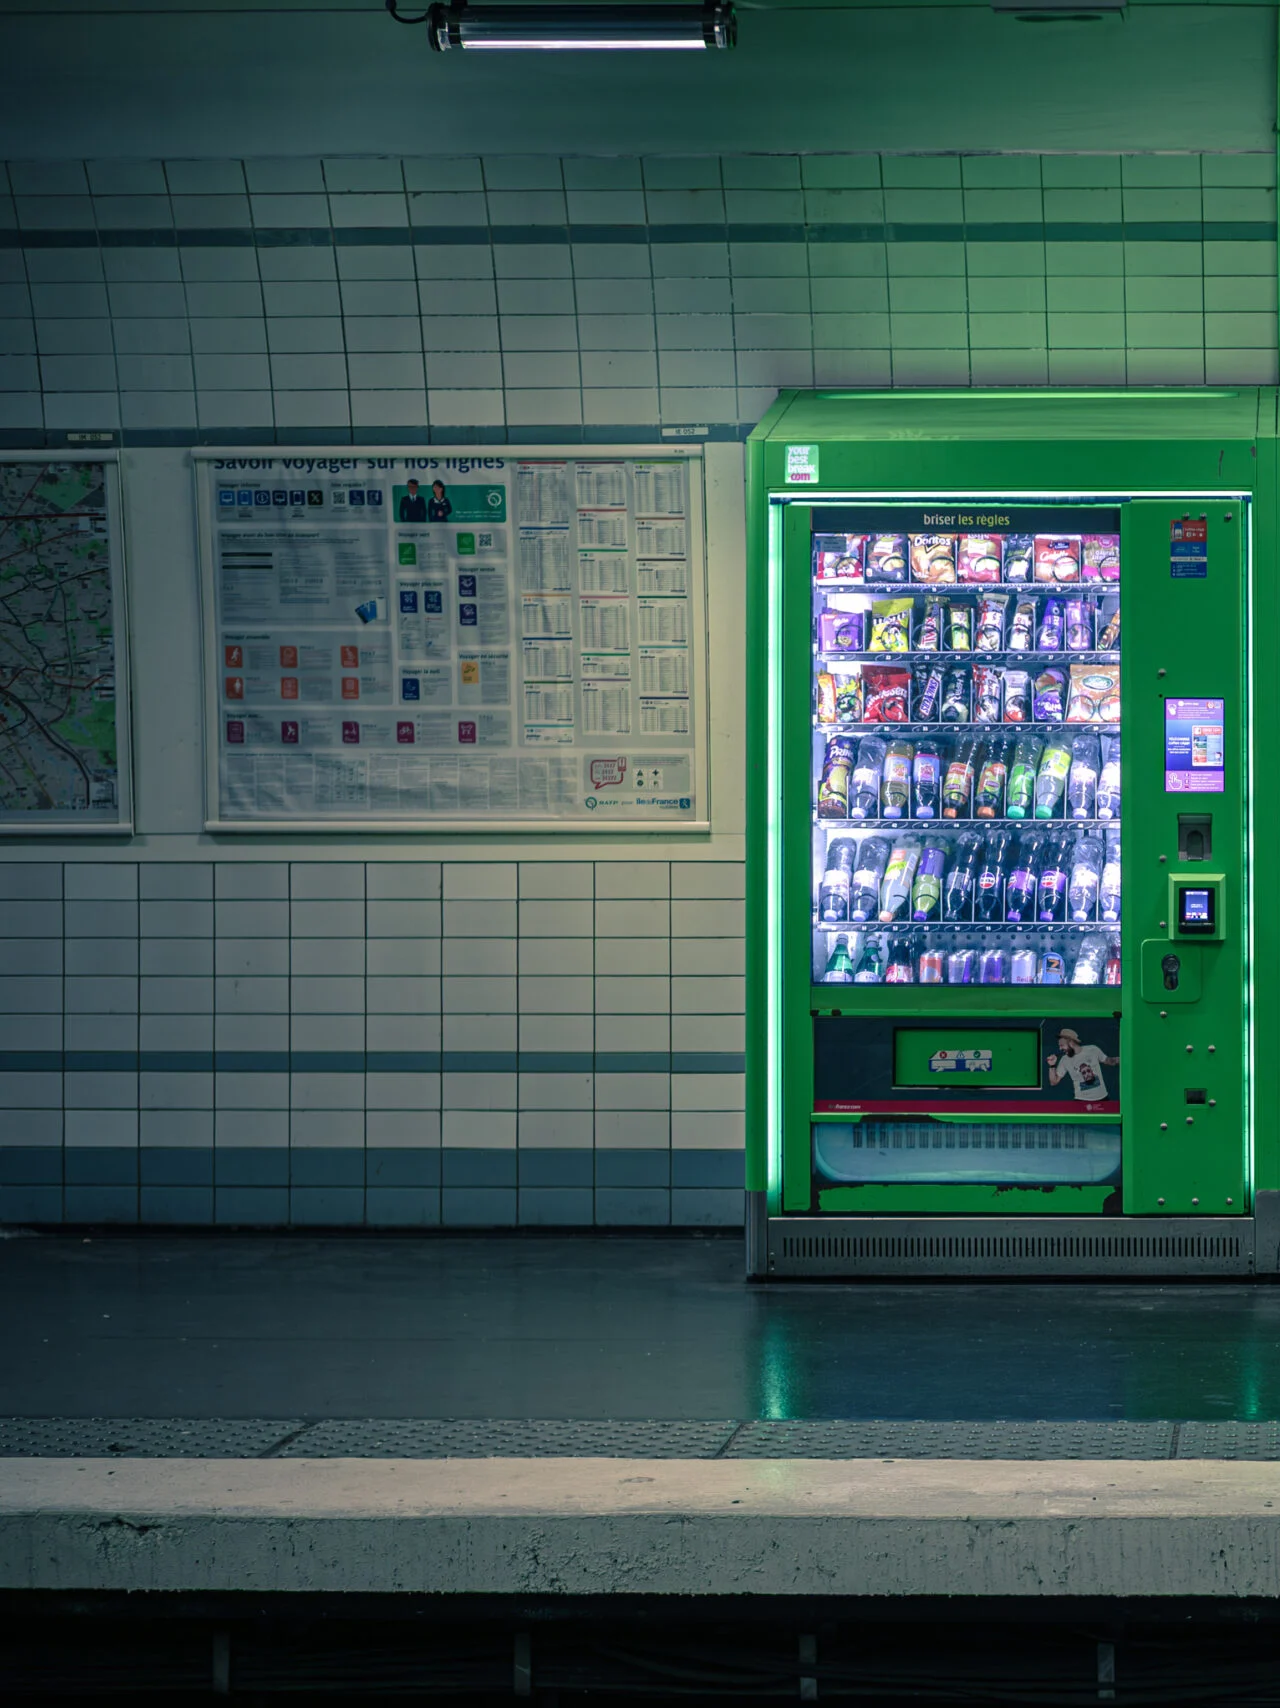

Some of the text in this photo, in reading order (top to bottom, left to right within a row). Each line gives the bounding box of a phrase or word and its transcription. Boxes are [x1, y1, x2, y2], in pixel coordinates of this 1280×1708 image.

[367, 458, 397, 470] sur
[405, 457, 439, 469] nos
[923, 513, 1010, 528] briser les règles
[914, 535, 951, 547] Doritos
[920, 678, 938, 714] SNICKERS
